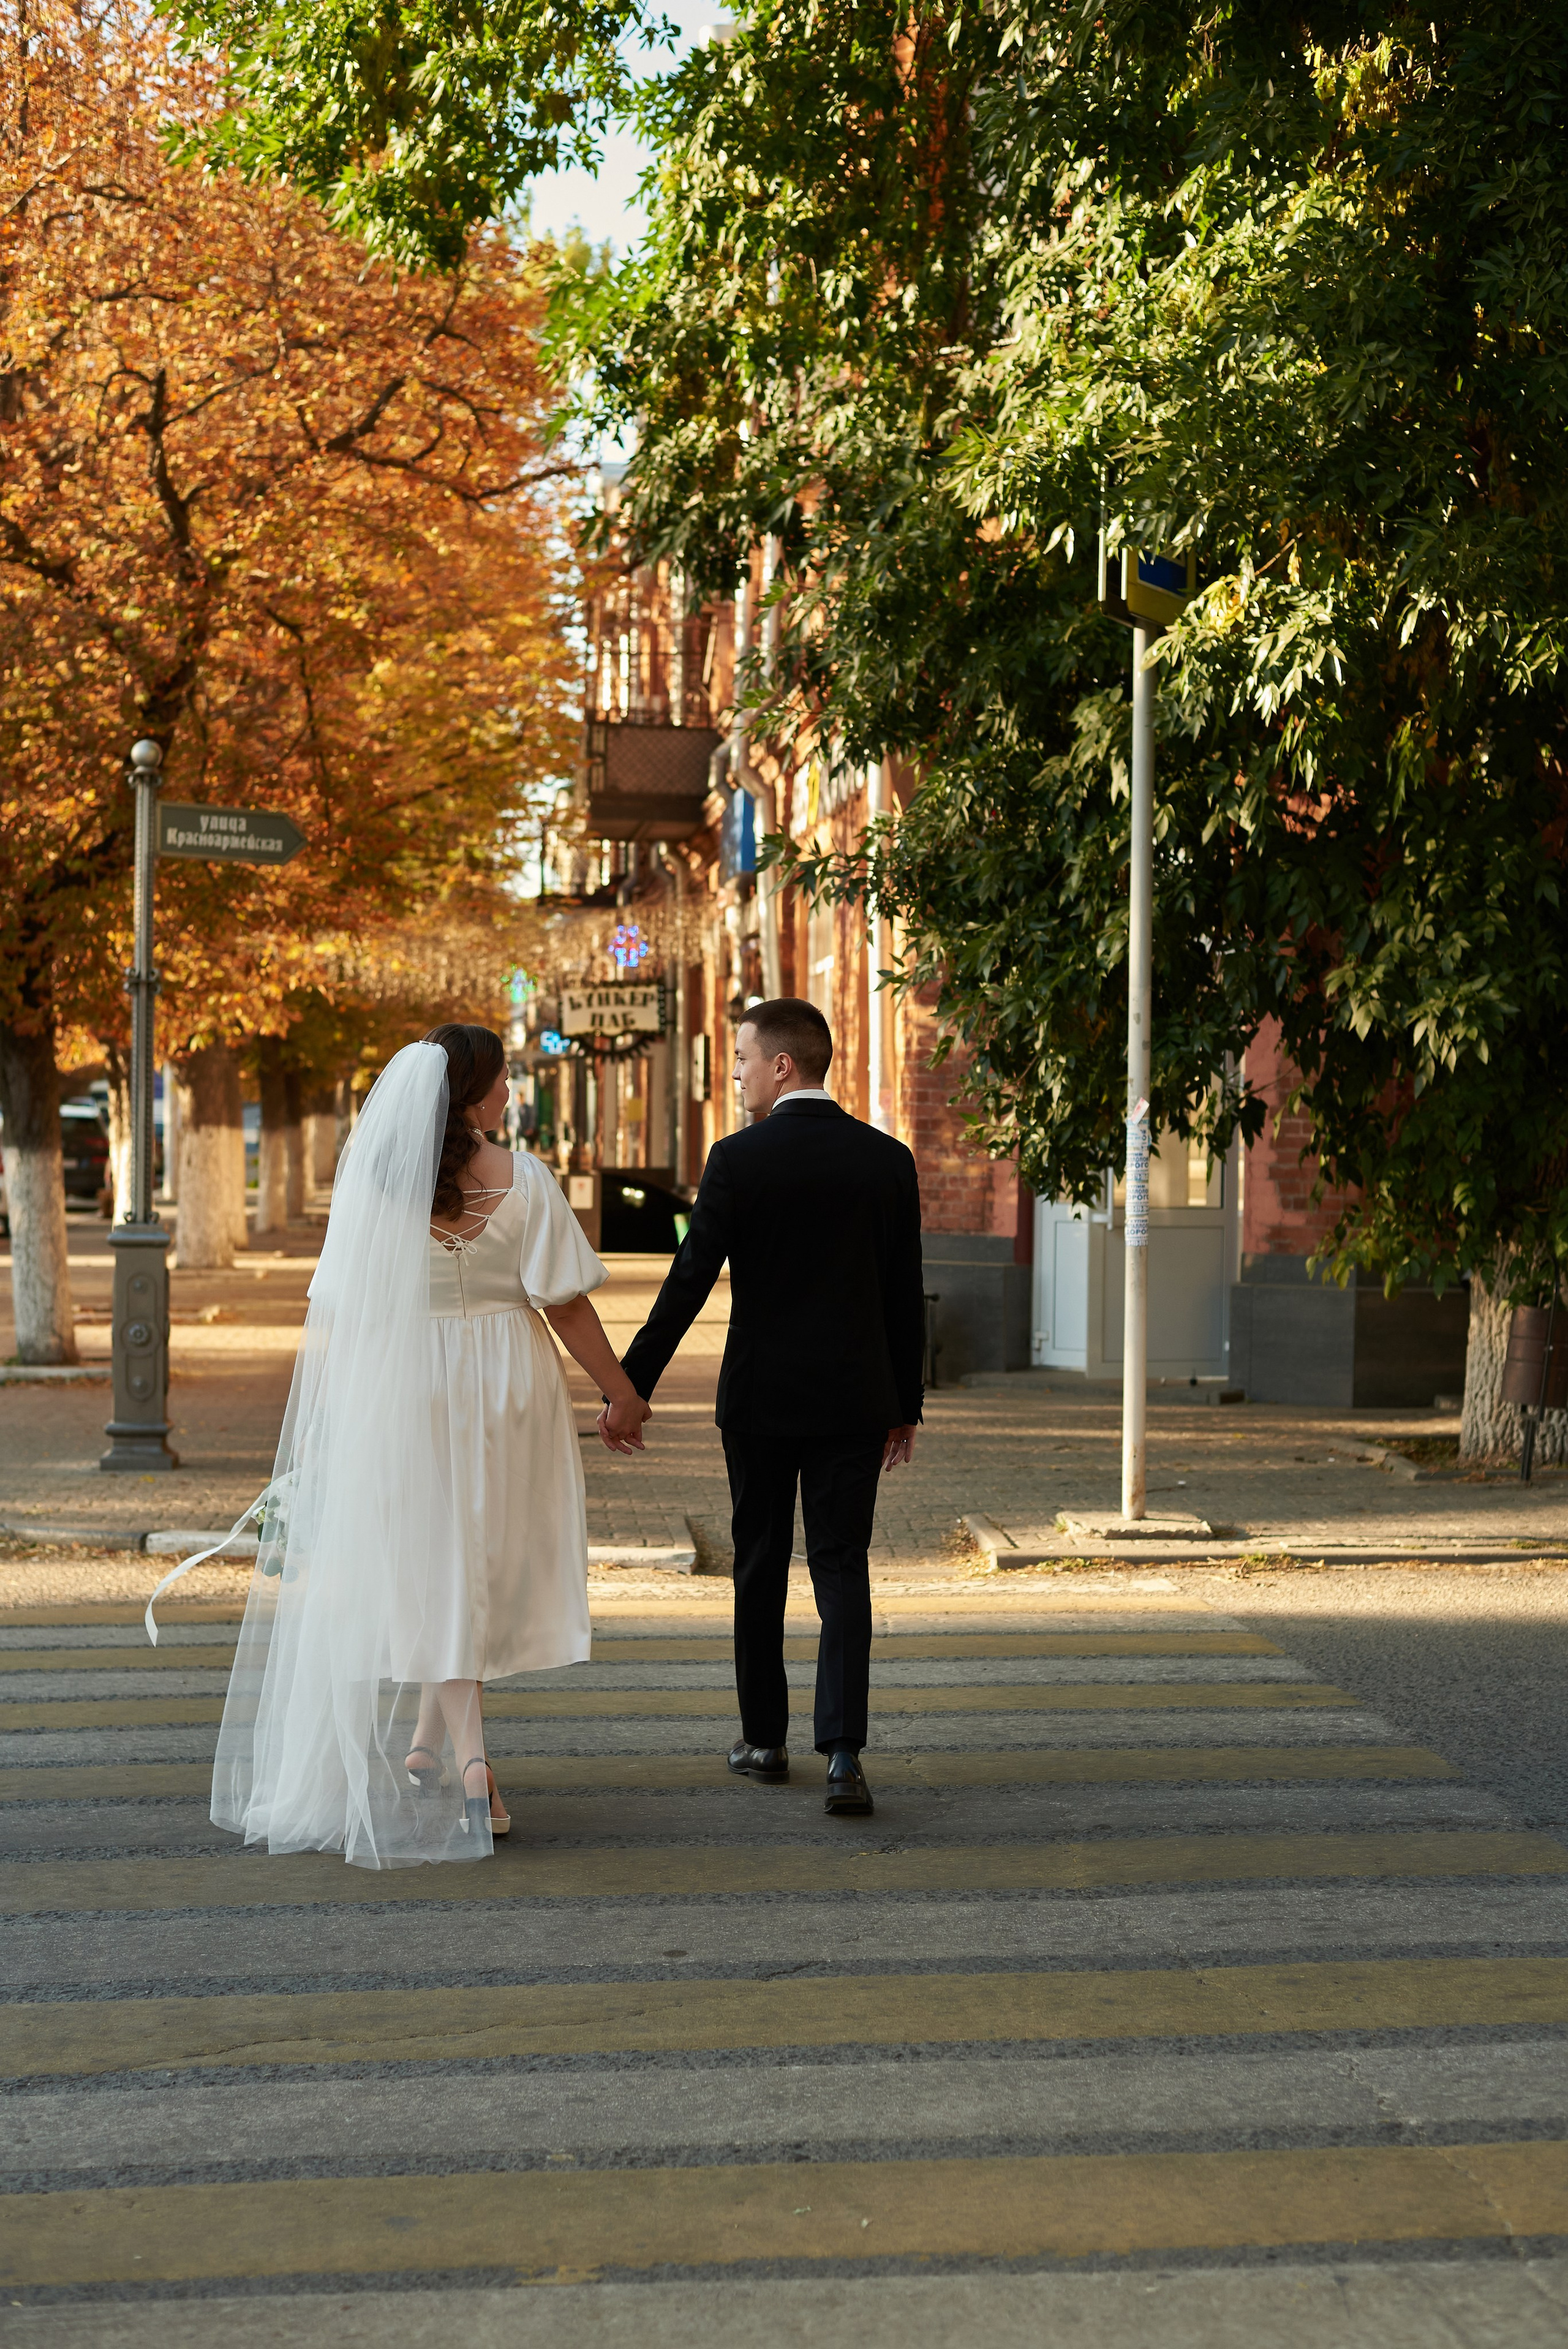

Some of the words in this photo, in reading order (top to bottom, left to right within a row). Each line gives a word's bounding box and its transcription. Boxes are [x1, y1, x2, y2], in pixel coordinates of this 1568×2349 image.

[200, 815, 247, 834] улица
[167, 827, 283, 852] Красноармейская
[568, 990, 654, 1011] БУНКЕР
